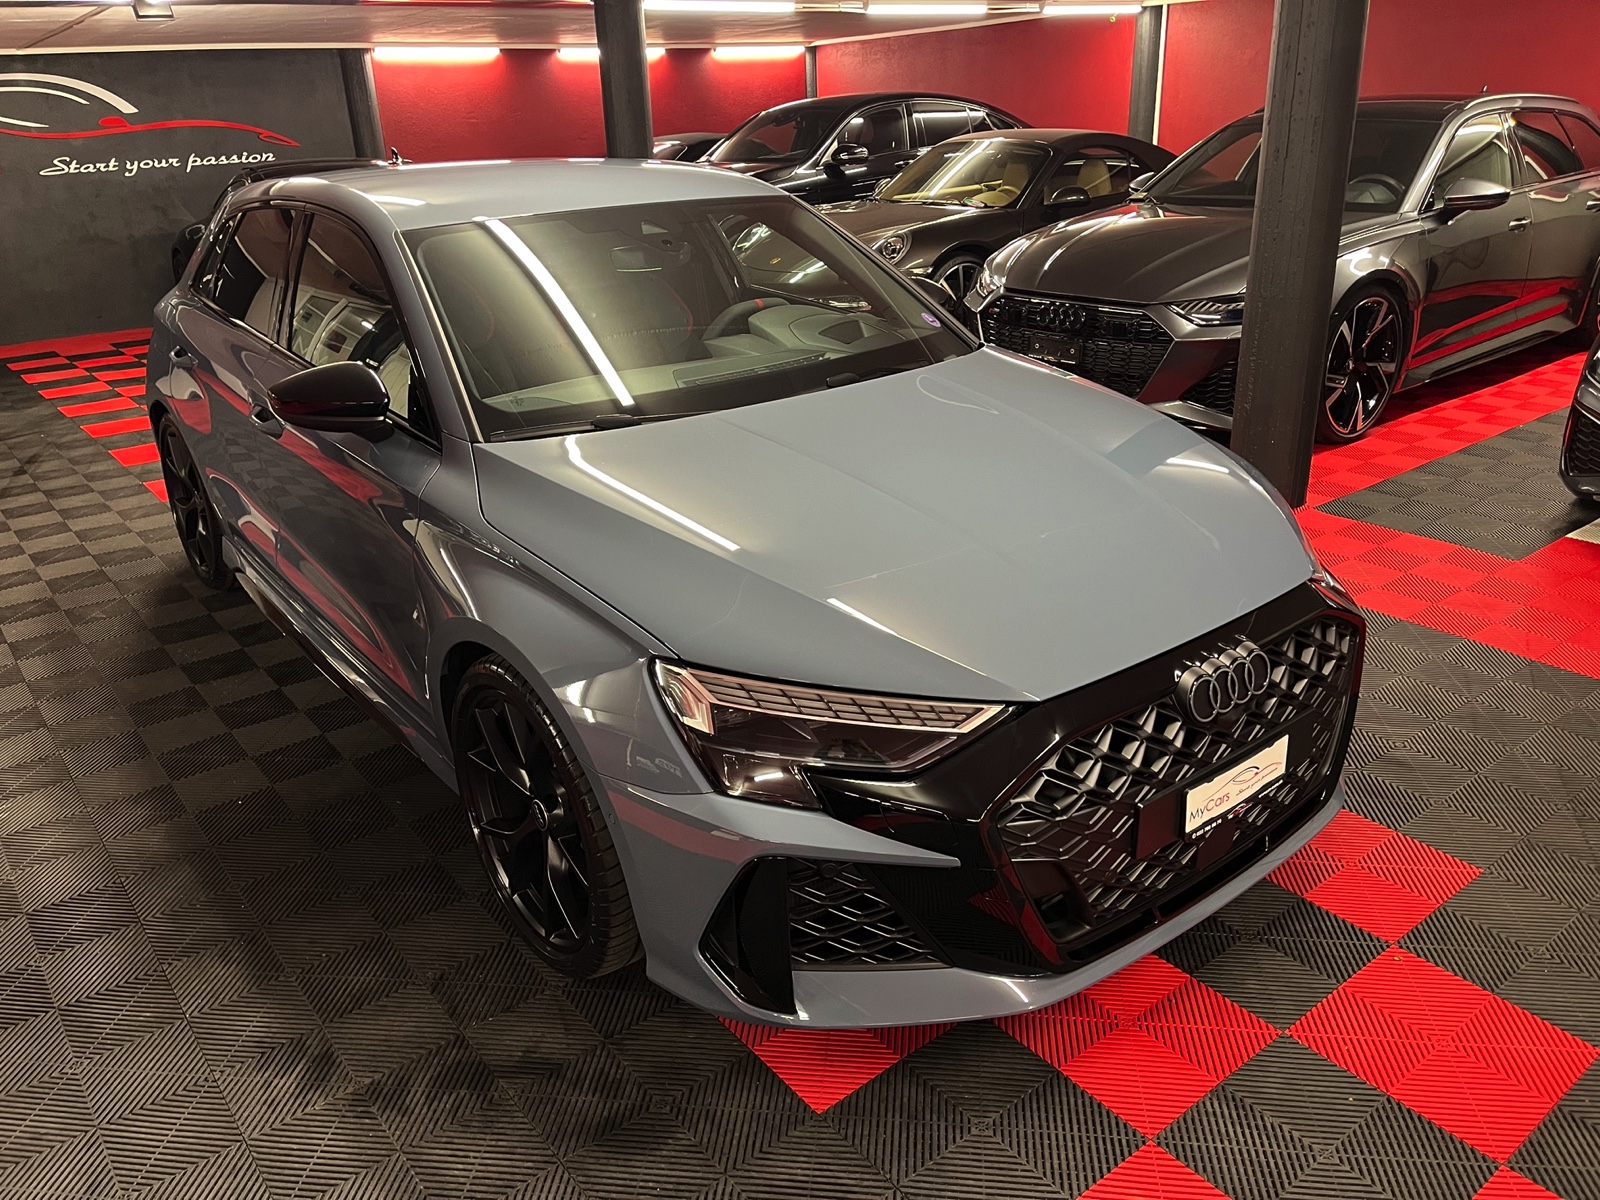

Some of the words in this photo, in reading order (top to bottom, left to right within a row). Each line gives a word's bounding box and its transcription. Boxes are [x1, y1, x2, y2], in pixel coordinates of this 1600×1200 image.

[39, 156, 119, 176] Start
[124, 155, 181, 177] your
[186, 151, 276, 173] passion
[1189, 792, 1230, 822] MyCars
